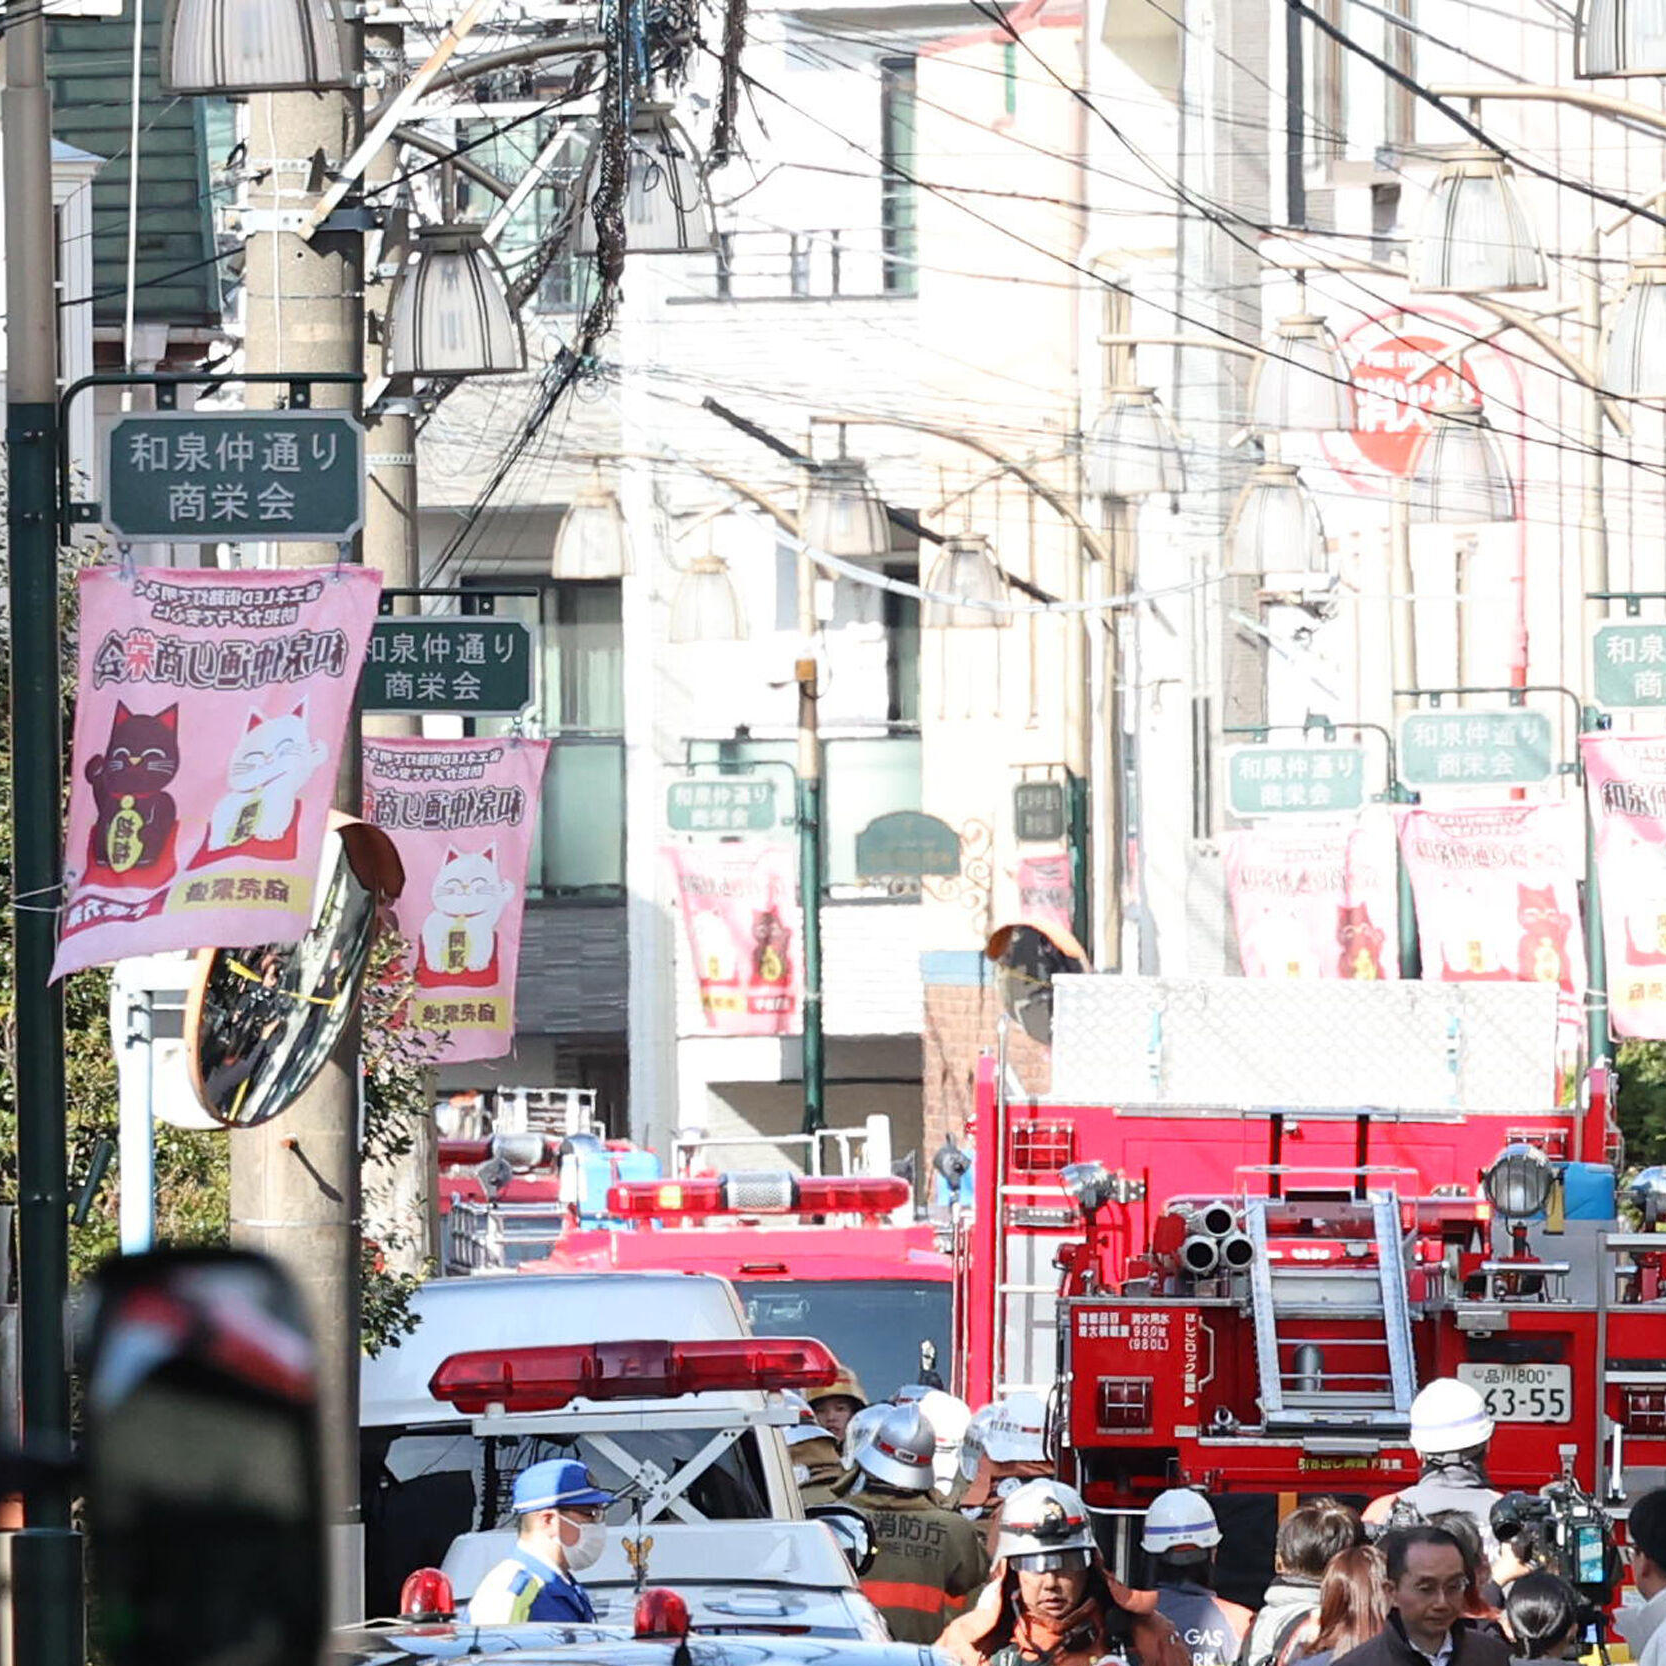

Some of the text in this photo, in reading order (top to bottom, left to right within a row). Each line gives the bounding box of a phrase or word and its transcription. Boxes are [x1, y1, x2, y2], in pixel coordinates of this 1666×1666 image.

[130, 432, 338, 472] 和泉仲通り
[168, 482, 295, 522] 商栄会
[385, 671, 482, 701] 商栄会
[1412, 717, 1539, 746] 和泉仲通り
[1239, 753, 1355, 780] 和泉仲通り
[1435, 750, 1516, 779] 商栄会
[1260, 784, 1331, 807] 商栄会
[1484, 1388, 1565, 1417] 63-55
[1184, 1628, 1224, 1647] GAS
